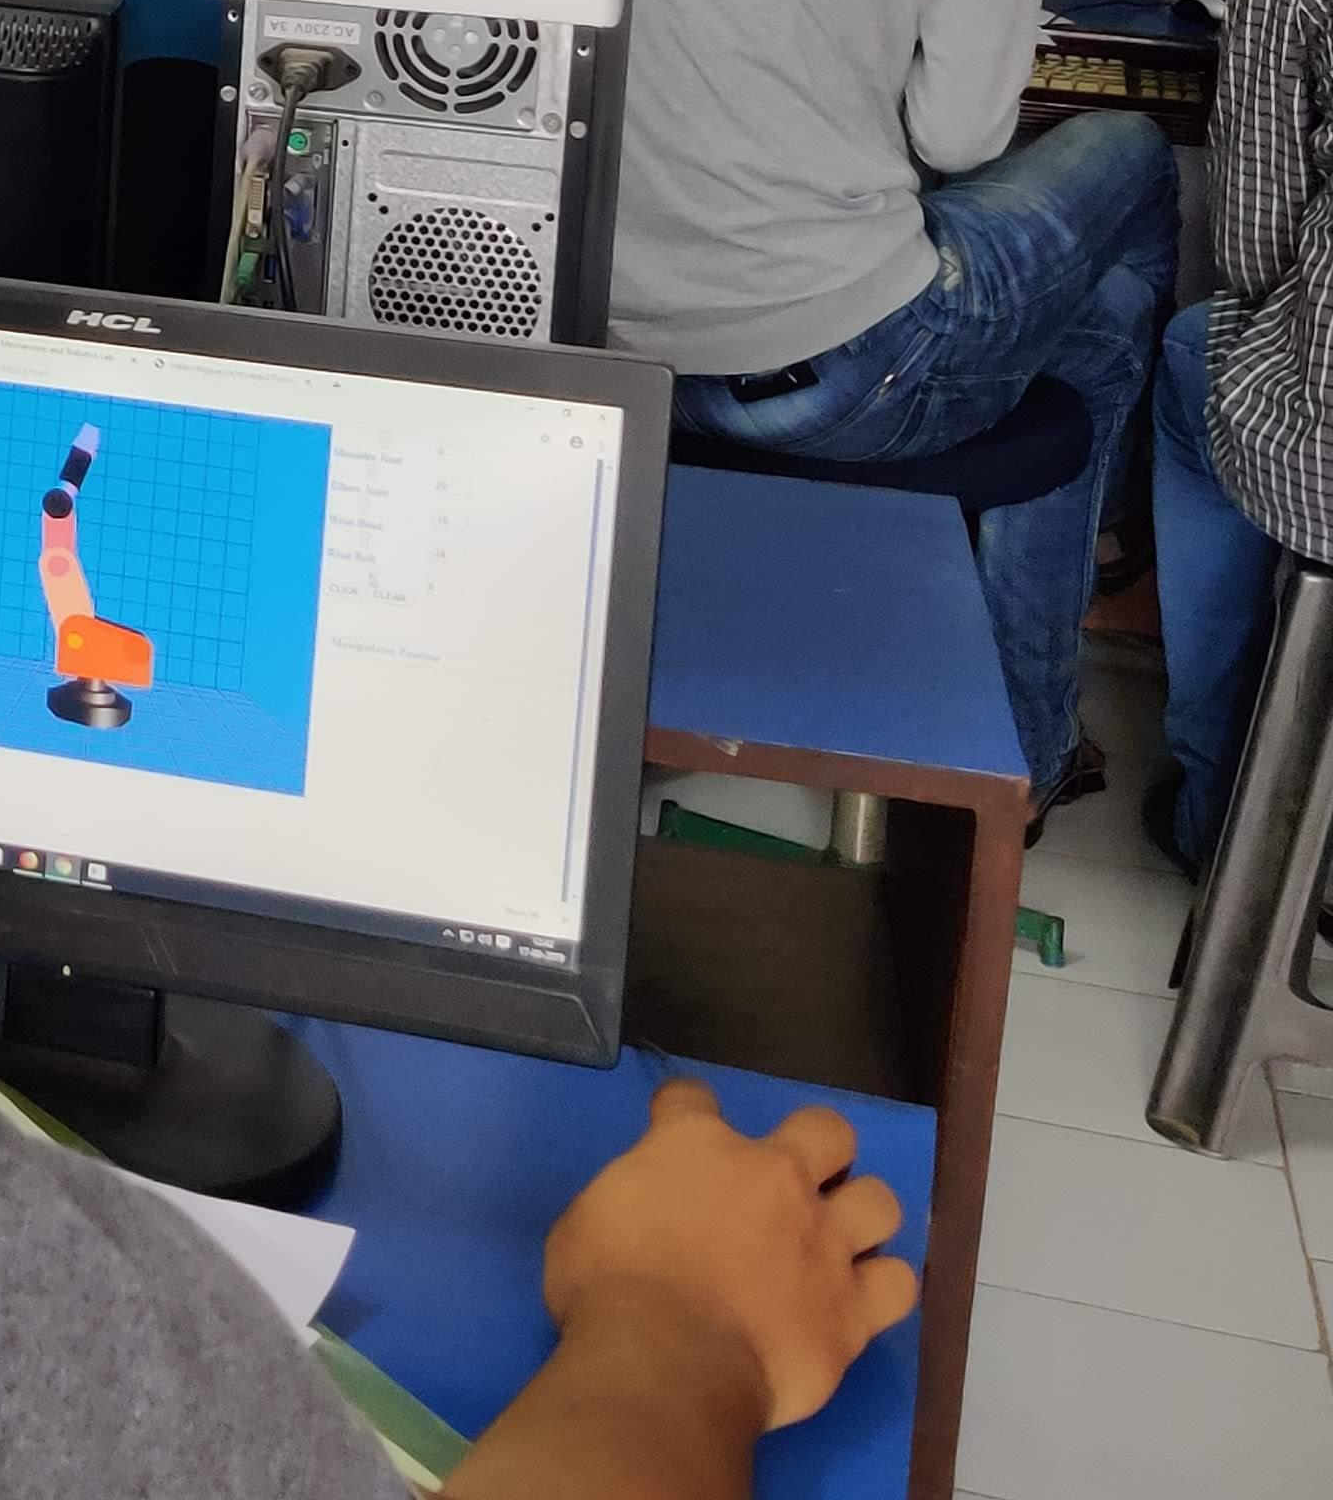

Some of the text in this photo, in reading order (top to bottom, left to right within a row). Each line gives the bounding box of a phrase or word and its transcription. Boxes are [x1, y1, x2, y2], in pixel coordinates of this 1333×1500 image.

[269, 20, 355, 38] AC 230V 3A
[66, 309, 162, 334] HCL
